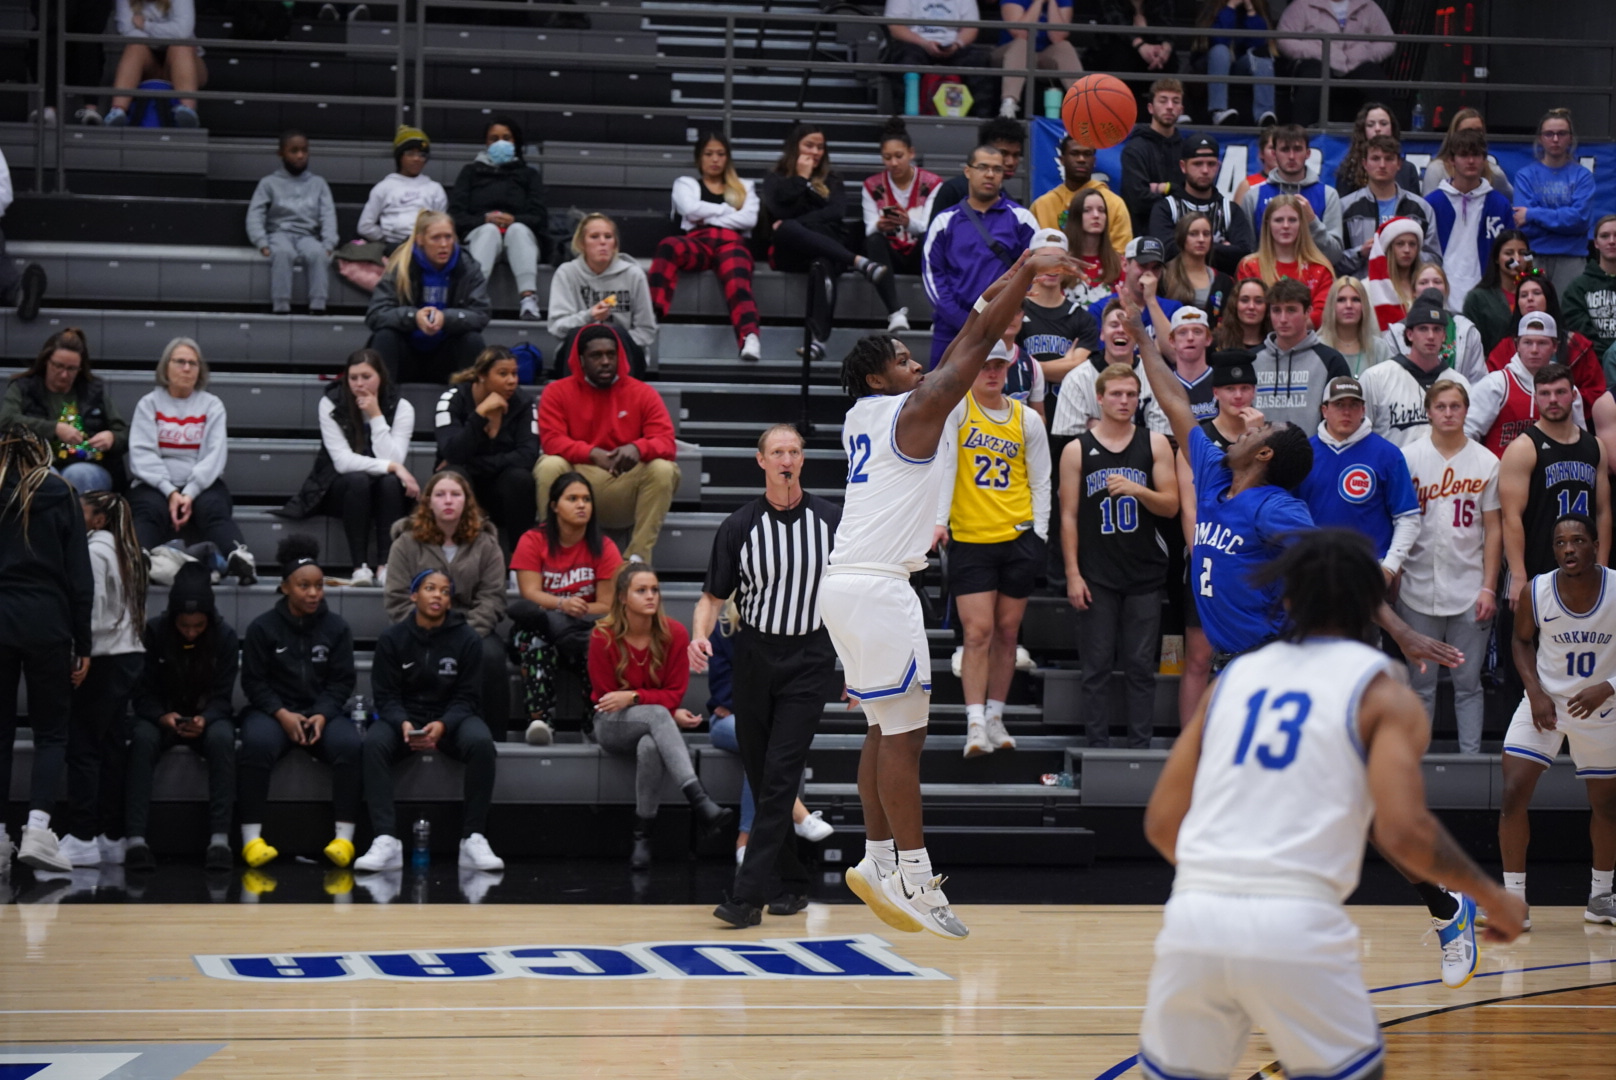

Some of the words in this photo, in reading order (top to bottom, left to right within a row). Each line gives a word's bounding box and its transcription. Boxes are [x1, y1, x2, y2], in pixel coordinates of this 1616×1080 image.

[1257, 370, 1310, 385] KIRKWOOD
[1255, 394, 1307, 410] BASEBALL
[962, 427, 1021, 459] LAKERS
[974, 455, 1011, 490] 23
[1545, 461, 1597, 490] KIRKWOOD
[1100, 496, 1139, 535] 10
[1453, 499, 1475, 528] 16
[1557, 489, 1589, 520] 14
[1200, 557, 1214, 598] 2
[1551, 631, 1613, 645] KIRKWOOD
[1566, 651, 1596, 679] 10
[1232, 688, 1313, 771] 13
